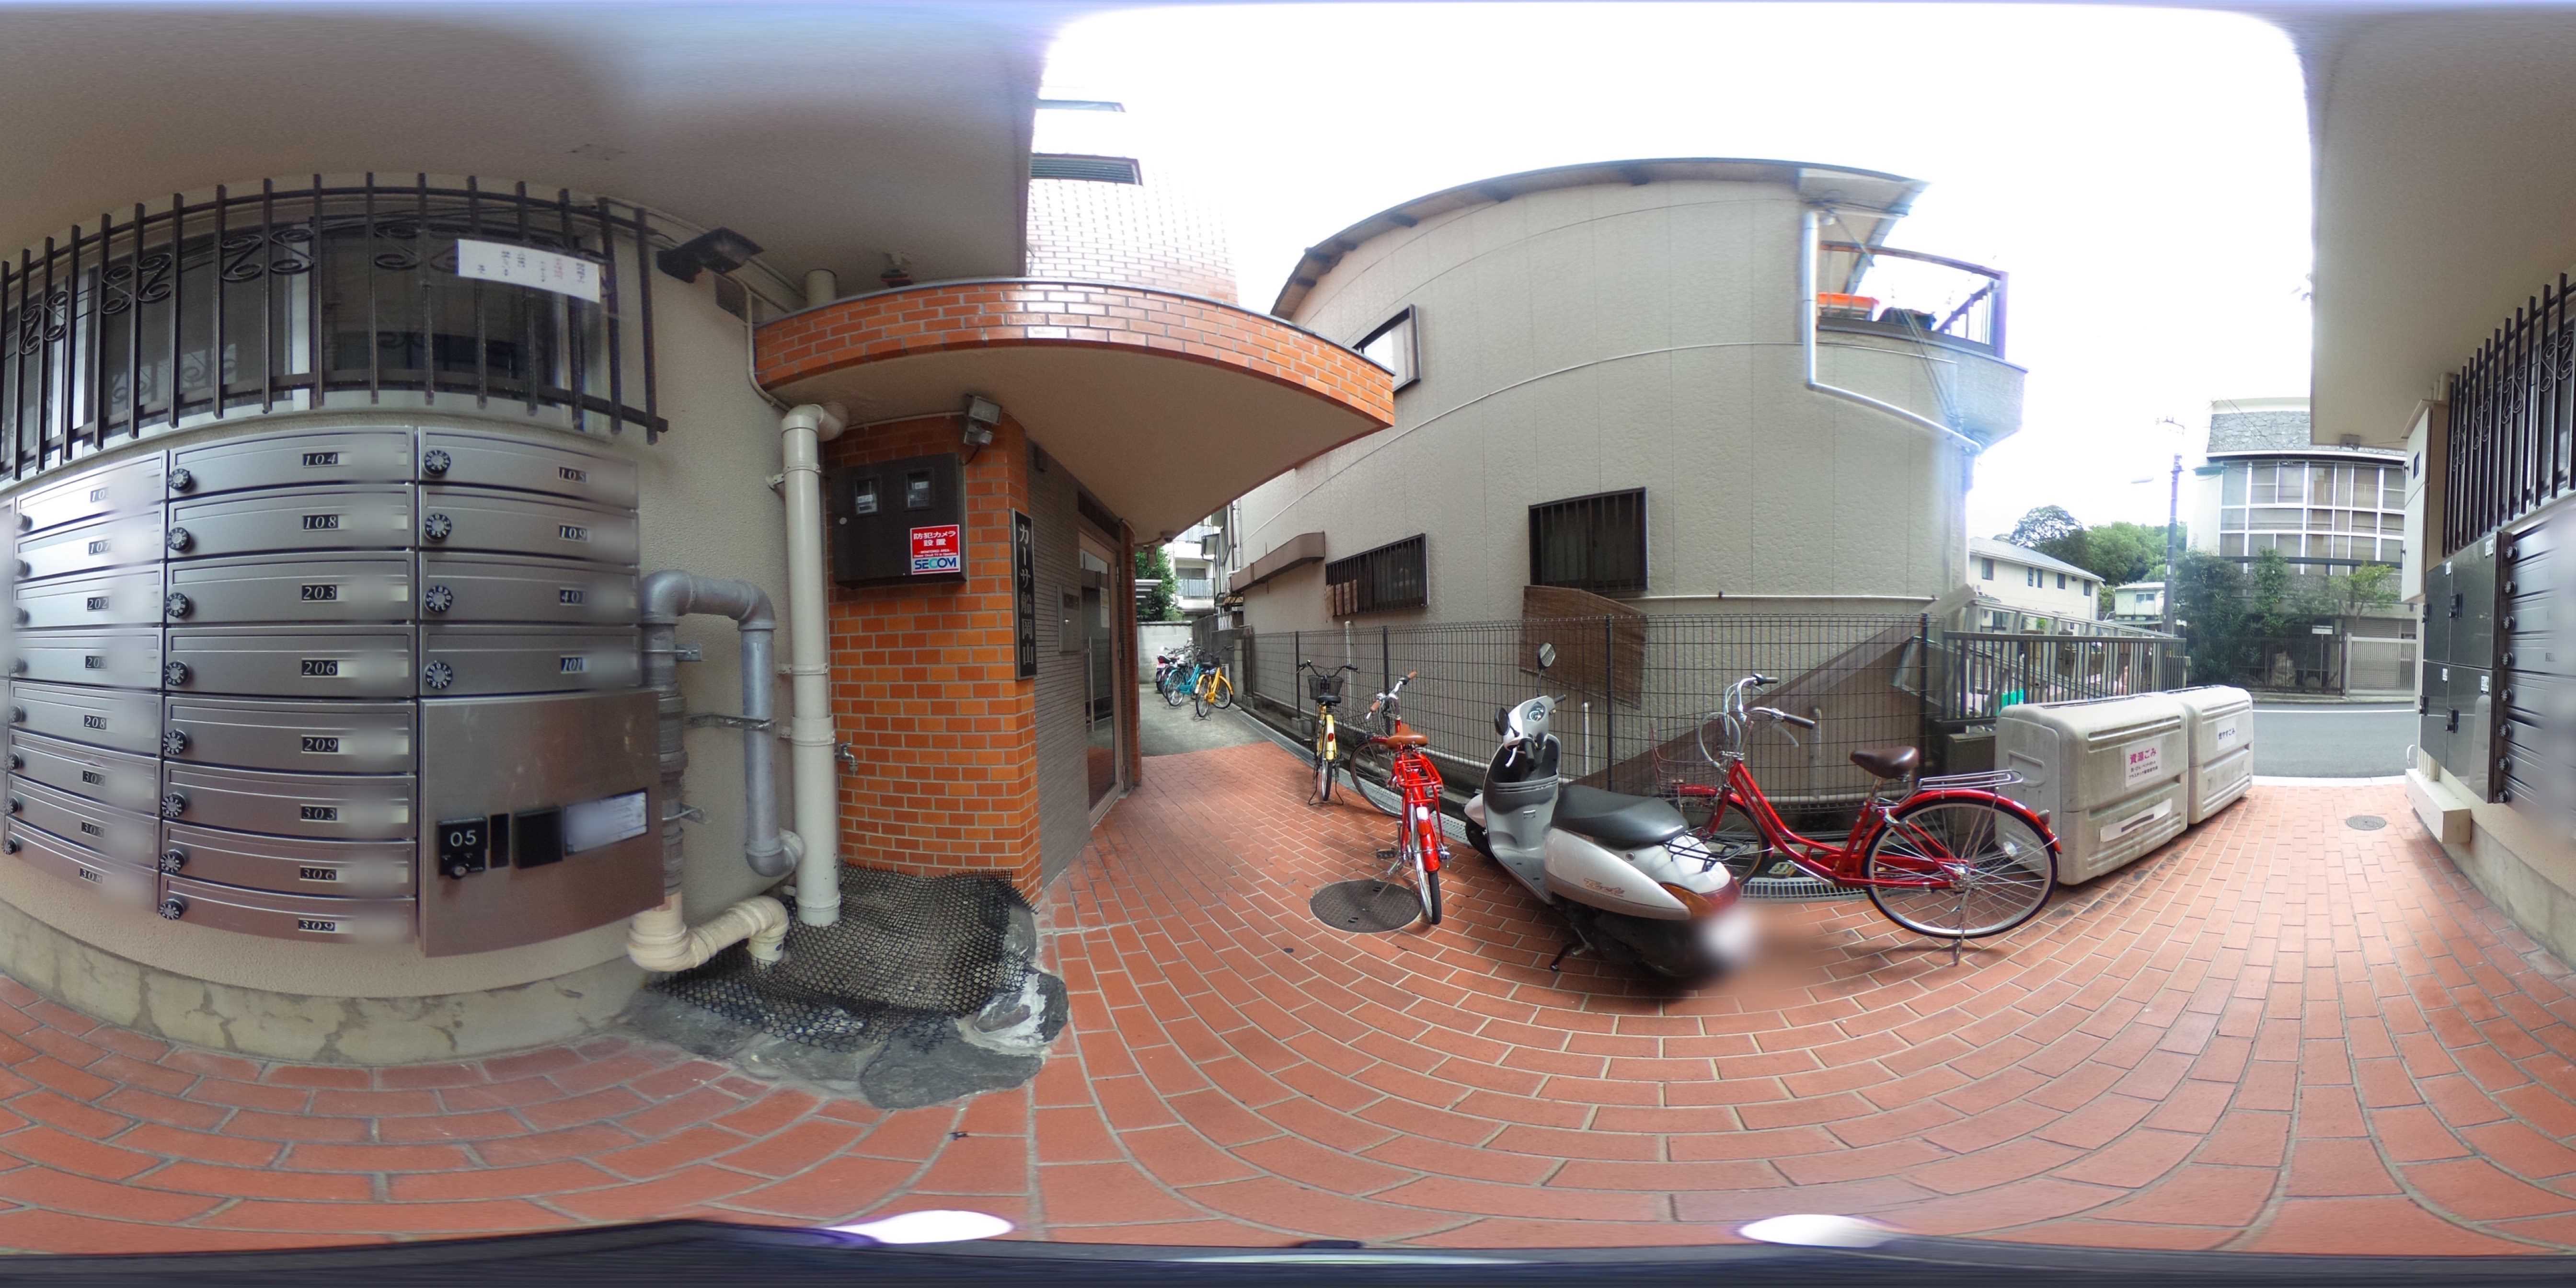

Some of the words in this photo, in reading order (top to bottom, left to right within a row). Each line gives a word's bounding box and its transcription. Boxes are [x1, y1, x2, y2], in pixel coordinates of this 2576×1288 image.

[305, 453, 336, 466] 104
[305, 516, 337, 529] 108
[561, 527, 586, 540] 109
[913, 531, 956, 540] 防犯カメラ
[90, 541, 110, 553] 107
[914, 557, 956, 570] SECOM
[303, 586, 335, 600] 203
[1019, 524, 1034, 666] カーサ船岡山
[88, 598, 108, 610] 202
[303, 662, 335, 675] 206
[562, 657, 582, 671] 101
[85, 716, 105, 729] 208
[304, 738, 337, 751] 209
[2130, 748, 2156, 765] 資源ごみ
[83, 772, 104, 785] 302
[302, 807, 336, 819] 303
[82, 823, 104, 837] 305
[450, 829, 476, 847] 05
[81, 869, 102, 882] 308
[301, 869, 334, 880] 306
[301, 920, 334, 931] 309
